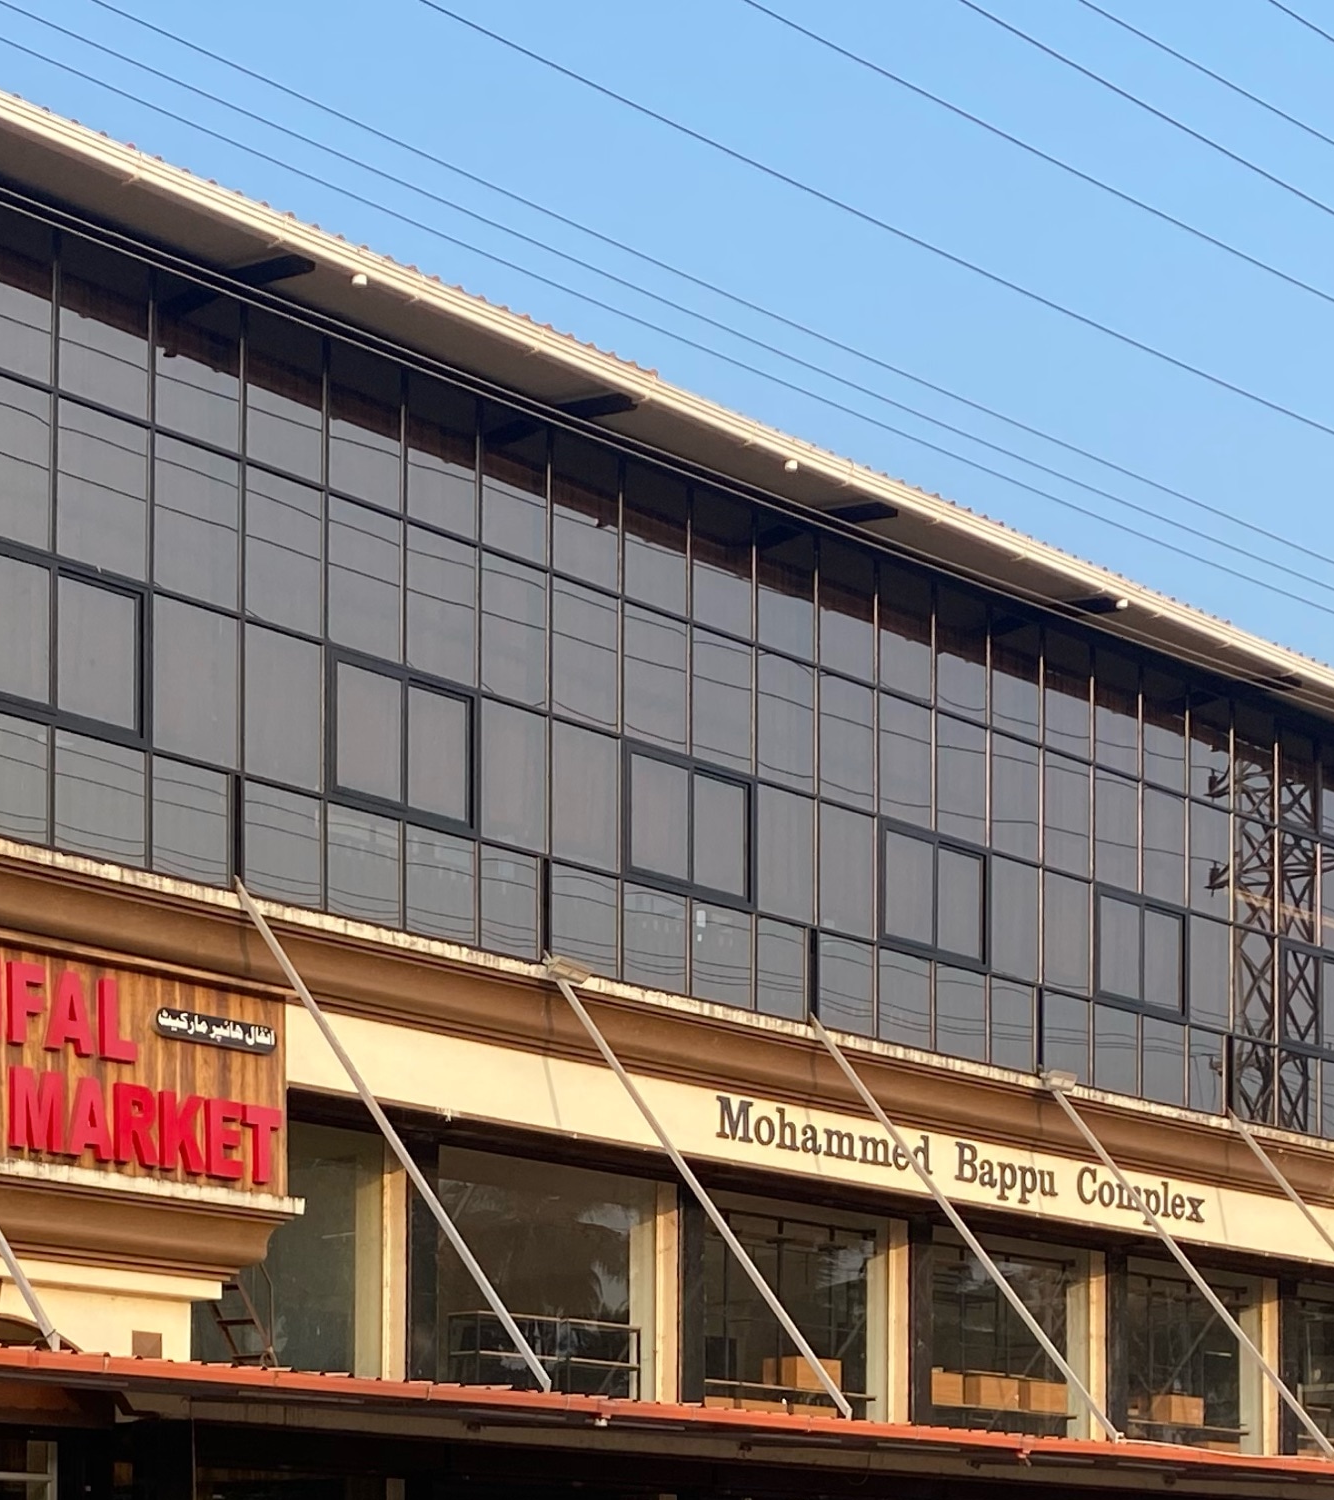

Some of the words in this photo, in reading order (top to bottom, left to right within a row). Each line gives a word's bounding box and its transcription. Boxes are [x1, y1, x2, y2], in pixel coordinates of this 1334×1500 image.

[9, 1066, 282, 1184] MARKET
[716, 1095, 933, 1175] Mohammed
[954, 1141, 1058, 1204] Bappu
[1077, 1166, 1205, 1225] Complex
